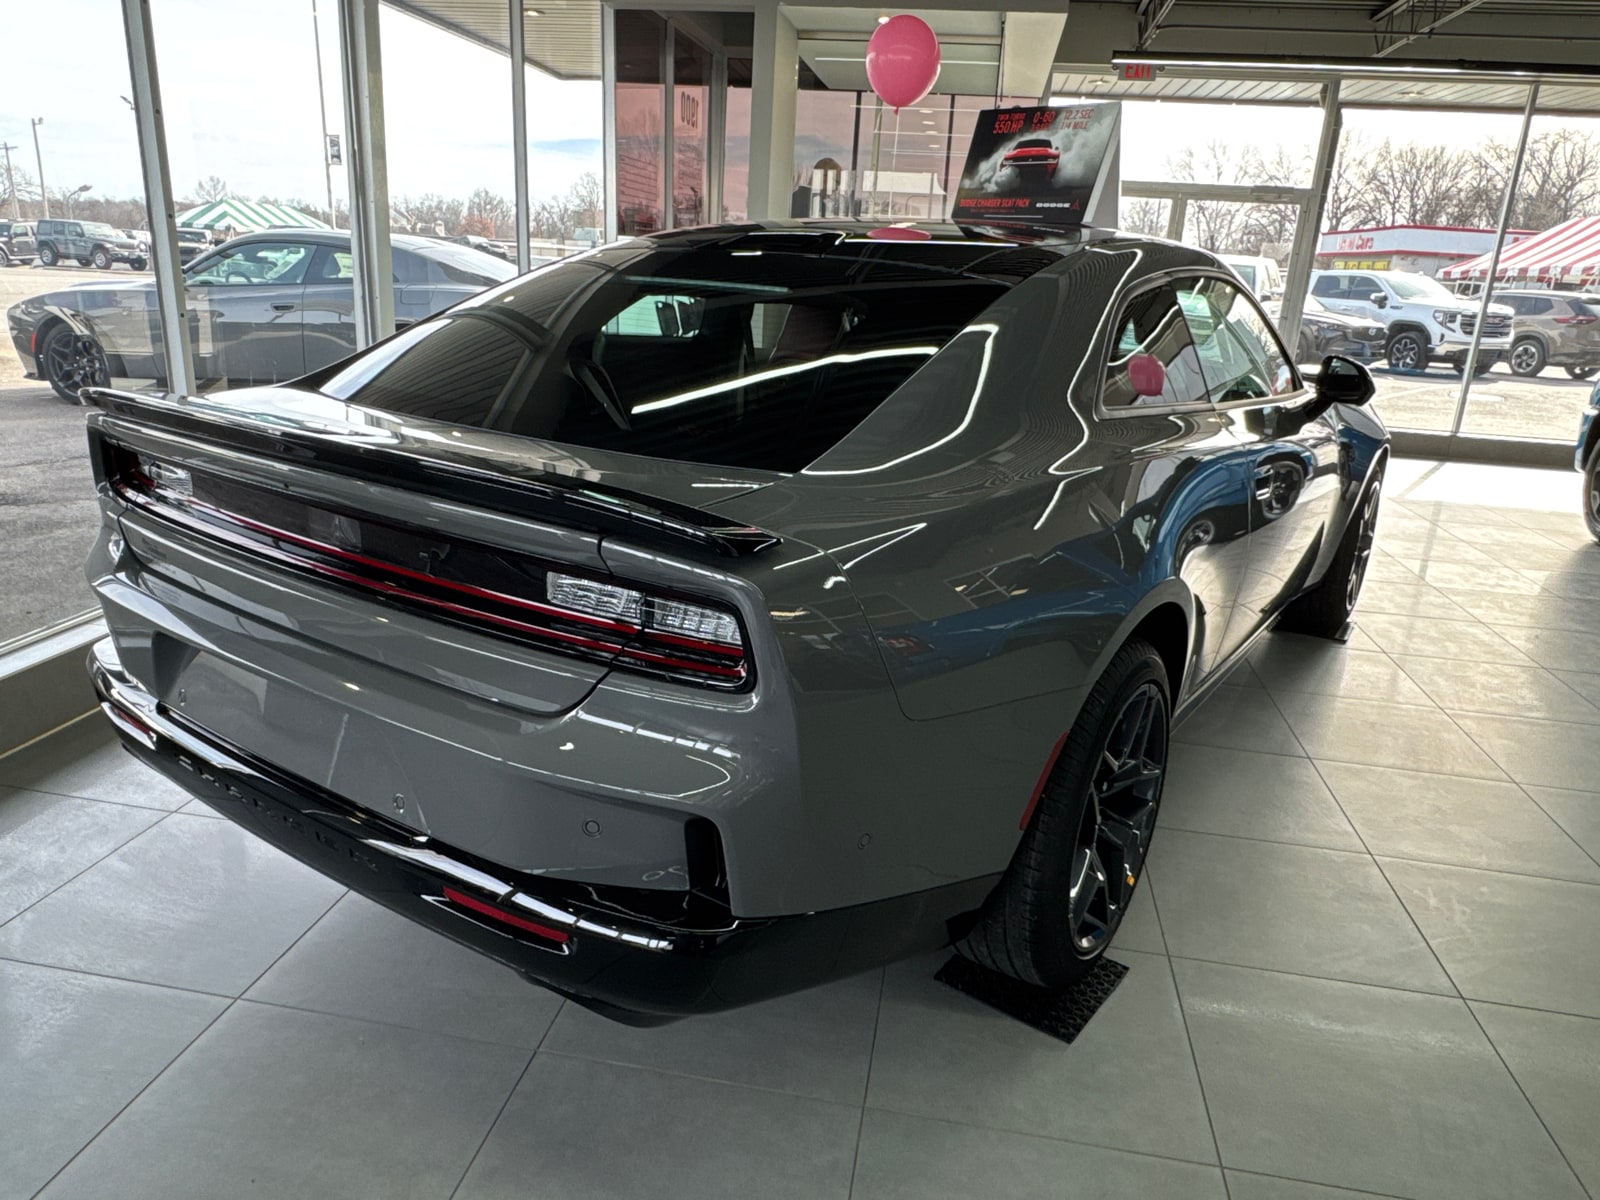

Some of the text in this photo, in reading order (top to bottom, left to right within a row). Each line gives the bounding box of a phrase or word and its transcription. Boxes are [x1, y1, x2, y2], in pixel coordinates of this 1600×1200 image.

[1125, 63, 1152, 79] EXIT
[1033, 111, 1056, 123] 0-60
[1079, 109, 1094, 119] SEC
[993, 120, 1024, 133] 550 HP
